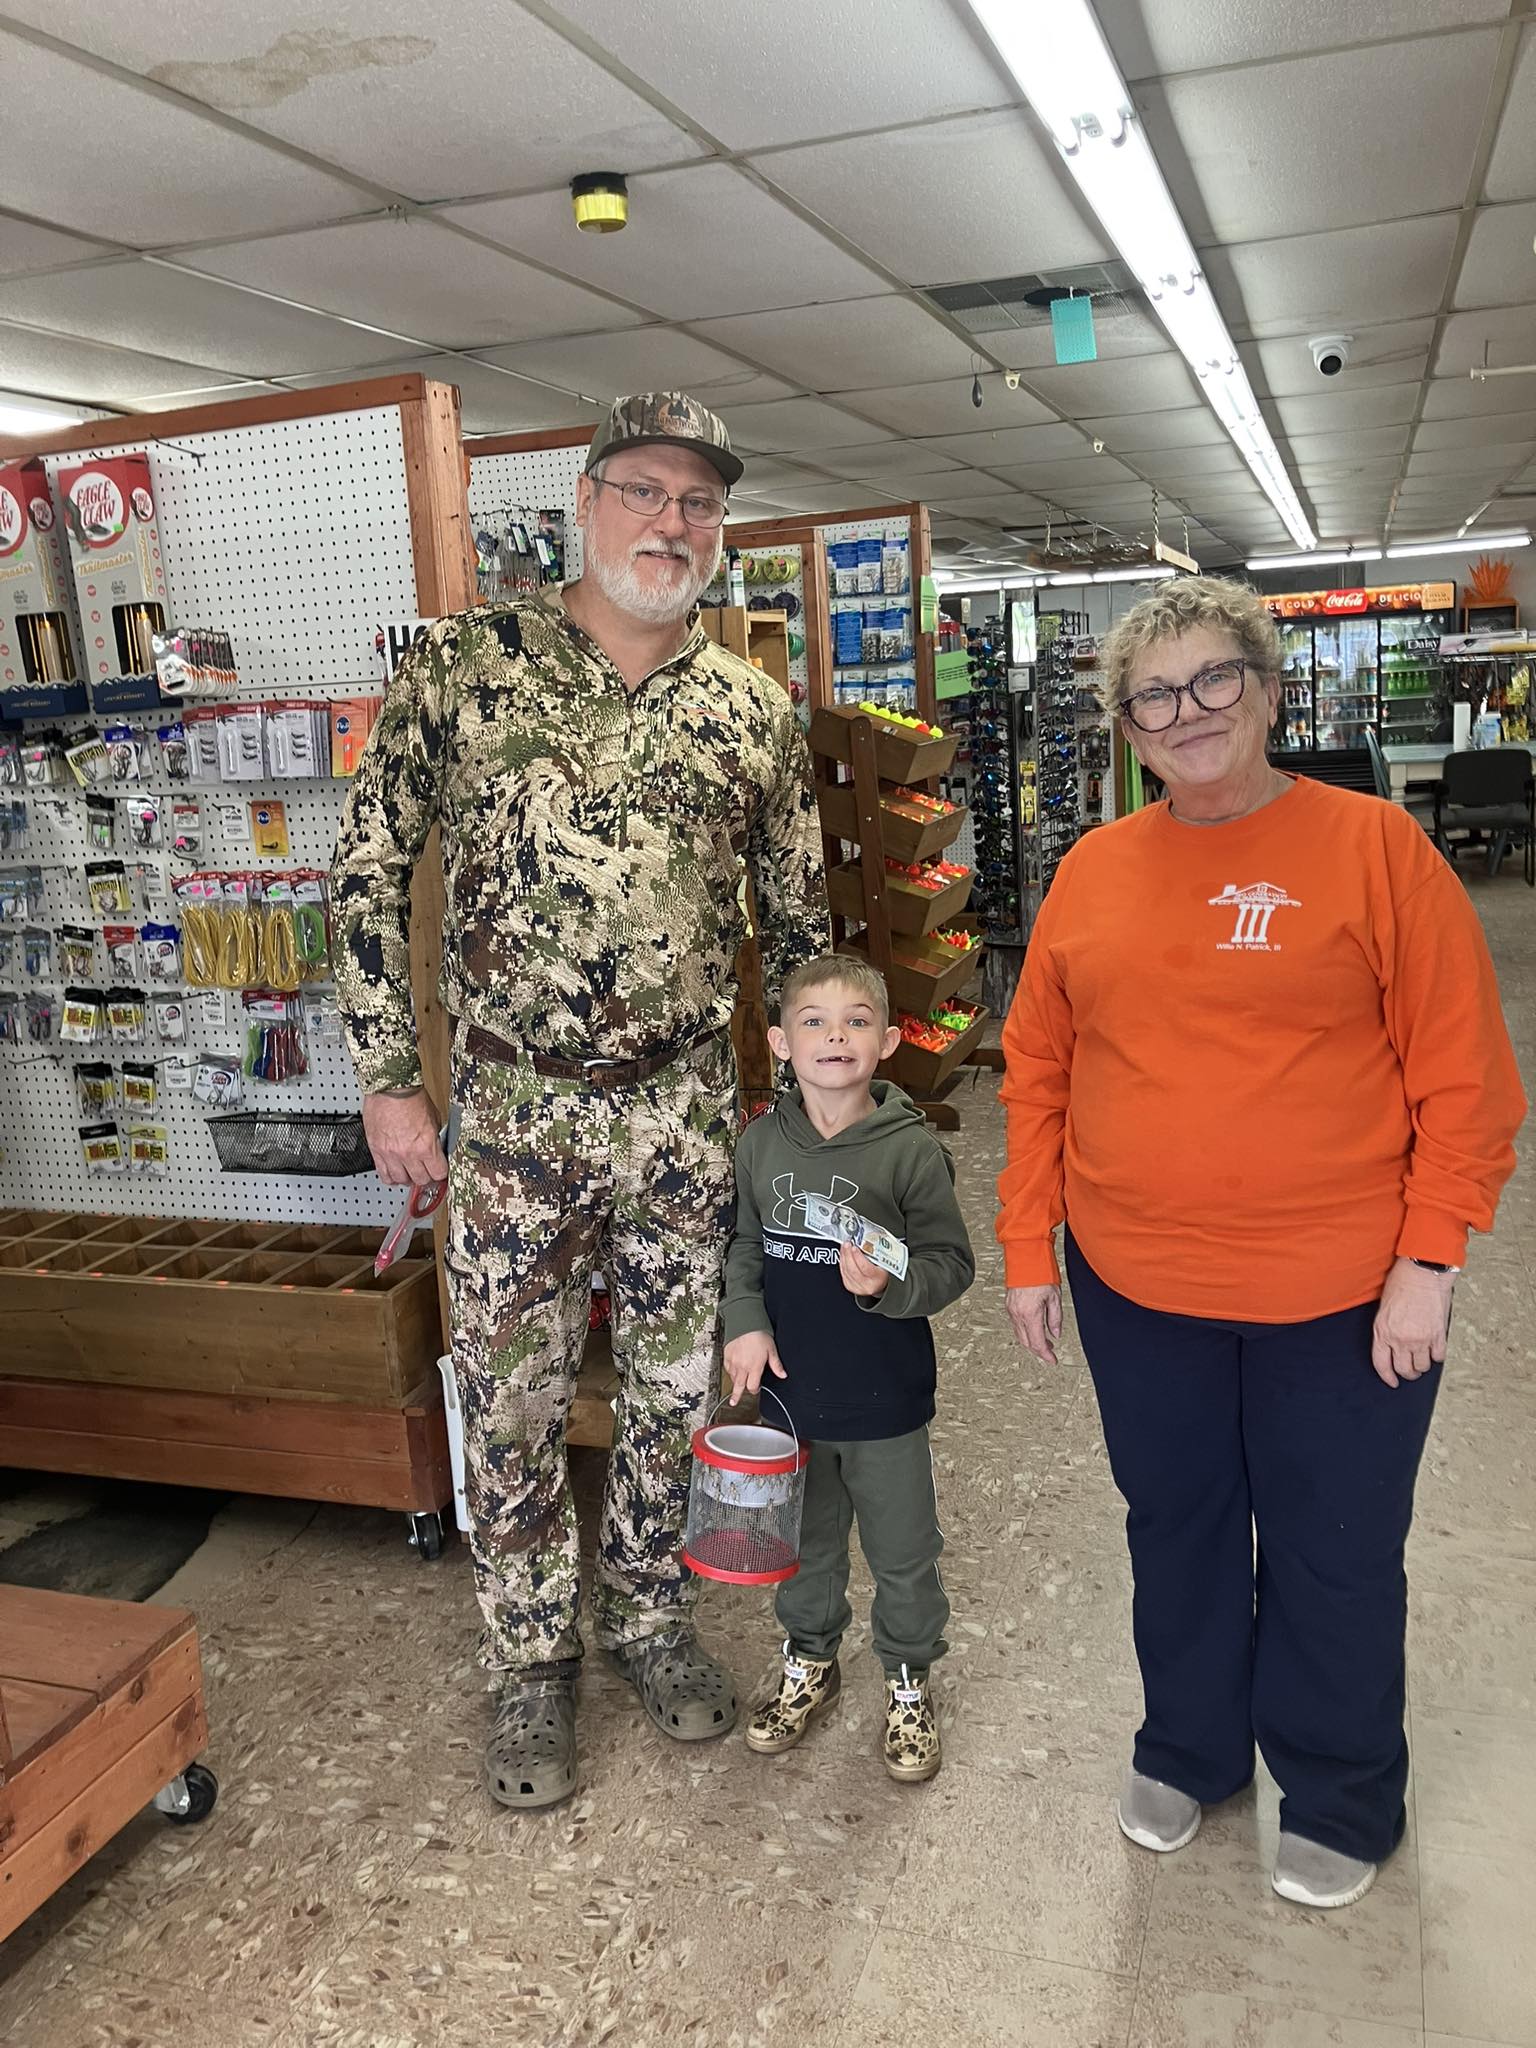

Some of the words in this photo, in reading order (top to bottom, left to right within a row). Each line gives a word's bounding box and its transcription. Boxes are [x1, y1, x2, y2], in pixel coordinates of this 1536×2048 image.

[76, 480, 111, 507] EAGLE
[82, 500, 116, 526] CLAW
[1286, 599, 1315, 609] COLD
[1326, 591, 1365, 608] Coca-Cola
[1379, 591, 1421, 604] DELICIO
[1407, 638, 1439, 651] Daisy
